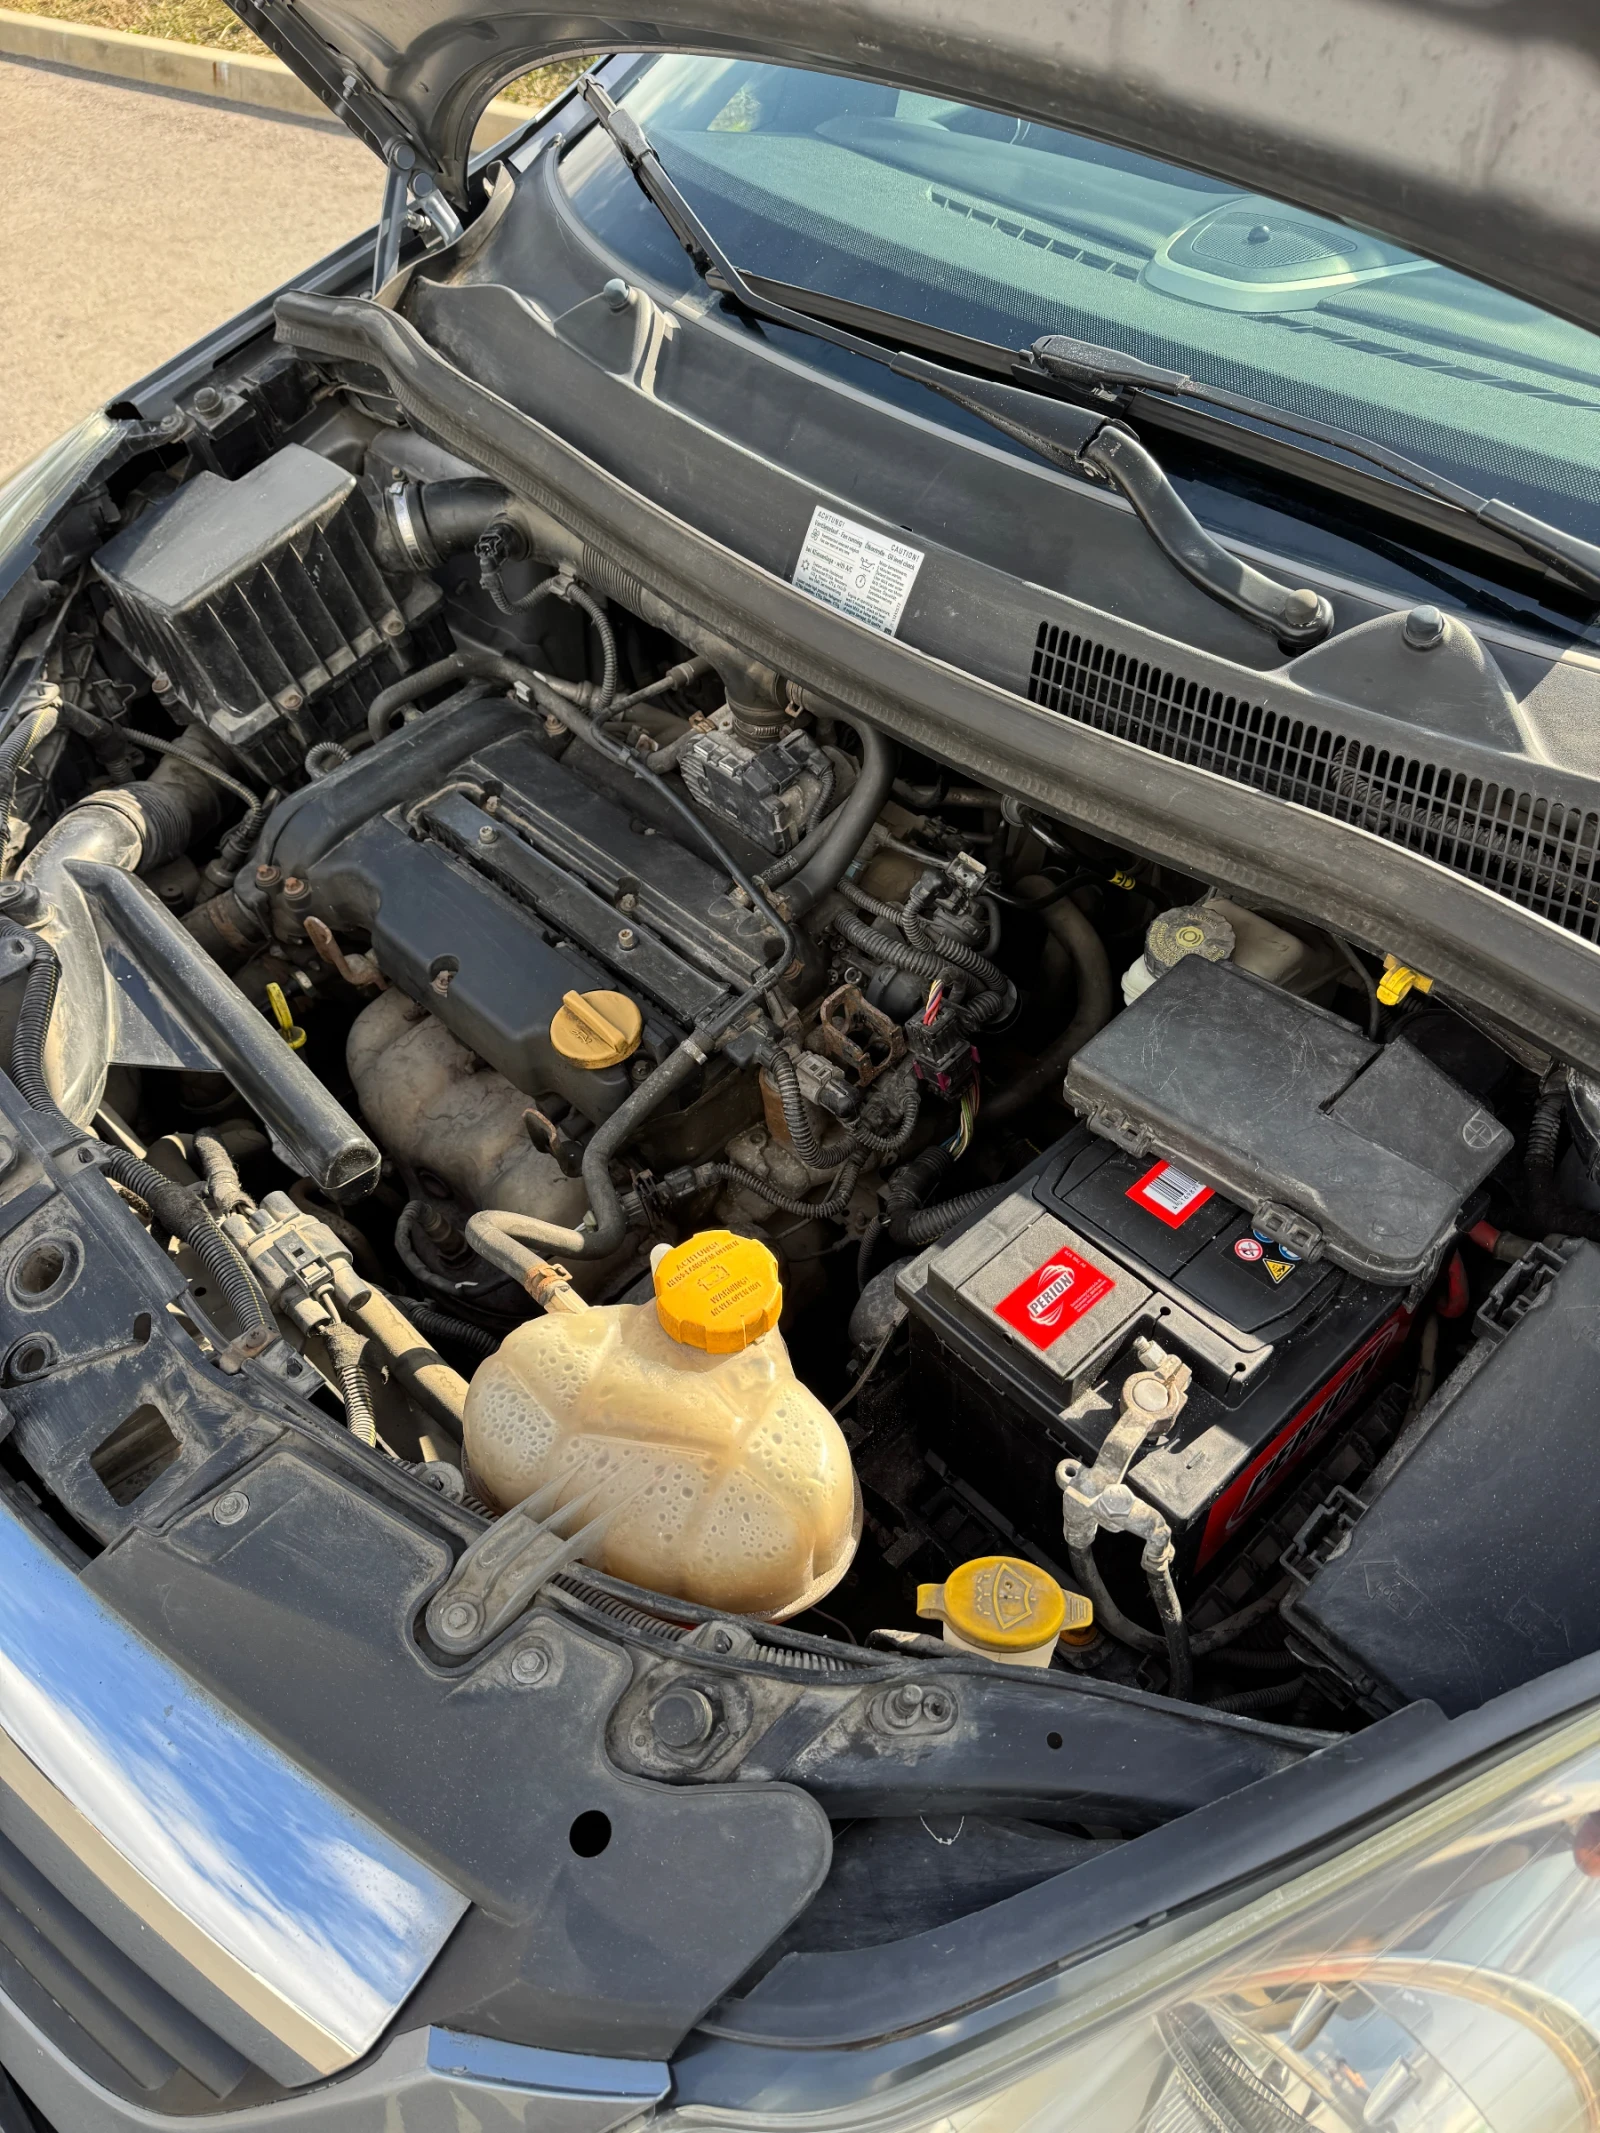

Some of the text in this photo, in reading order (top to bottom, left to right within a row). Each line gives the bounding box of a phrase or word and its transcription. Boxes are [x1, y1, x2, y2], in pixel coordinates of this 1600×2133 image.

[817, 510, 845, 528] ACHTUNG!
[890, 543, 919, 562] CAUTION!
[902, 560, 915, 570] check
[676, 1241, 719, 1271] ACHTUNG!
[710, 1276, 750, 1304] WARNING!
[710, 1281, 762, 1317] NEVER OPEN HOT
[1029, 1274, 1072, 1315] PERION
